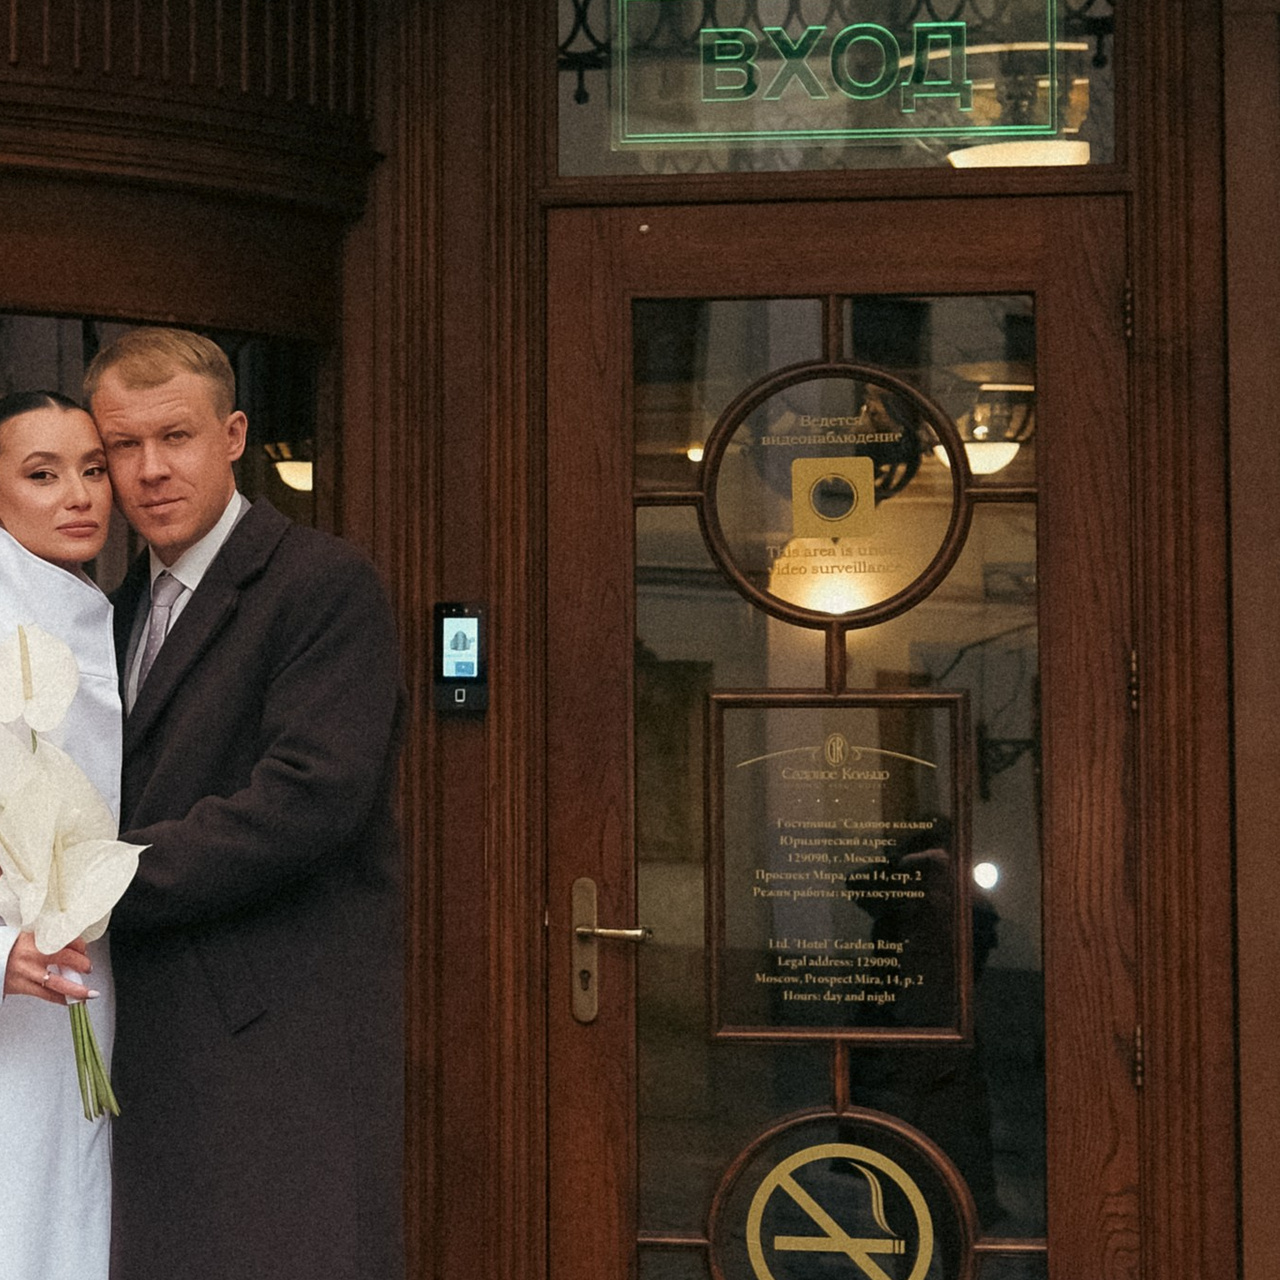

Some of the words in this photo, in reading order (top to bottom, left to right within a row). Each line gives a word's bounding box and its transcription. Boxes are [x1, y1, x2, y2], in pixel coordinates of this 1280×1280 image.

[699, 21, 973, 114] ВХОД
[799, 414, 864, 428] Ведется
[761, 431, 903, 446] видеонаблюдение
[766, 545, 801, 558] This
[804, 546, 836, 558] area
[840, 545, 853, 557] is
[767, 563, 808, 576] video
[779, 835, 860, 849] Юридический
[862, 838, 897, 849] адрес:
[788, 852, 831, 864] 129090,
[844, 852, 889, 864] Москва,
[755, 869, 810, 884] Проспект
[813, 869, 847, 884] Мира,
[849, 872, 870, 881] дом
[873, 870, 889, 882] 14,
[891, 872, 913, 884] стр.
[915, 870, 922, 881] 2
[752, 886, 791, 897] Режим
[793, 886, 839, 901] работы:
[840, 889, 925, 901] круглосуточно
[769, 938, 791, 949] Ltd.
[777, 955, 807, 970] Legal
[808, 955, 854, 967] address:
[857, 956, 901, 969] 129090,
[755, 972, 803, 985] Moscow,
[804, 973, 853, 987] Prospect
[855, 973, 884, 985] Mira,
[886, 974, 903, 986] 14,
[904, 976, 915, 988] p.
[917, 974, 924, 985] 2
[783, 990, 821, 1001] Hours:
[822, 990, 842, 1004] day
[844, 990, 865, 1001] and
[866, 990, 896, 1006] night
